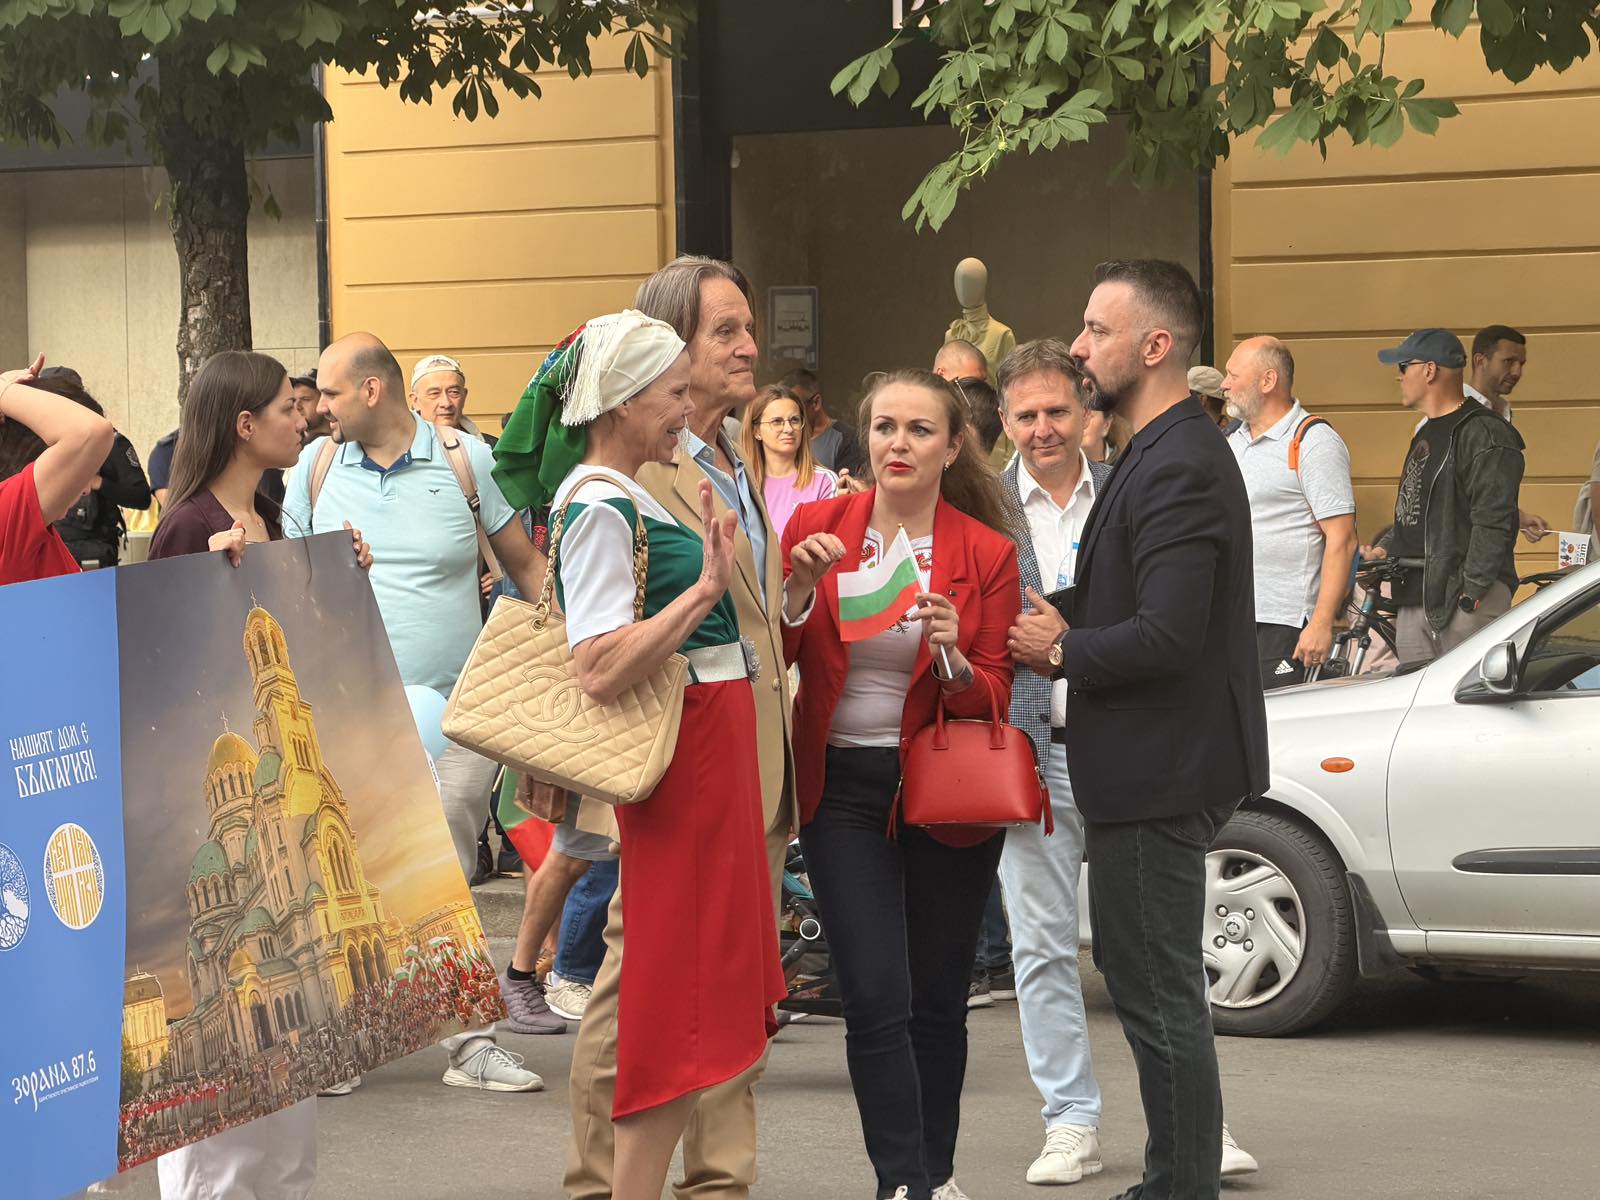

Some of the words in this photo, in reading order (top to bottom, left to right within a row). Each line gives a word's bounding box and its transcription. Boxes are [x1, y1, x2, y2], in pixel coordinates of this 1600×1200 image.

[9, 730, 55, 761] НАШИЯТ
[57, 724, 80, 751] ДОМ
[14, 749, 98, 798] БЪЛГАРИЯ!
[71, 1050, 96, 1078] 87.6
